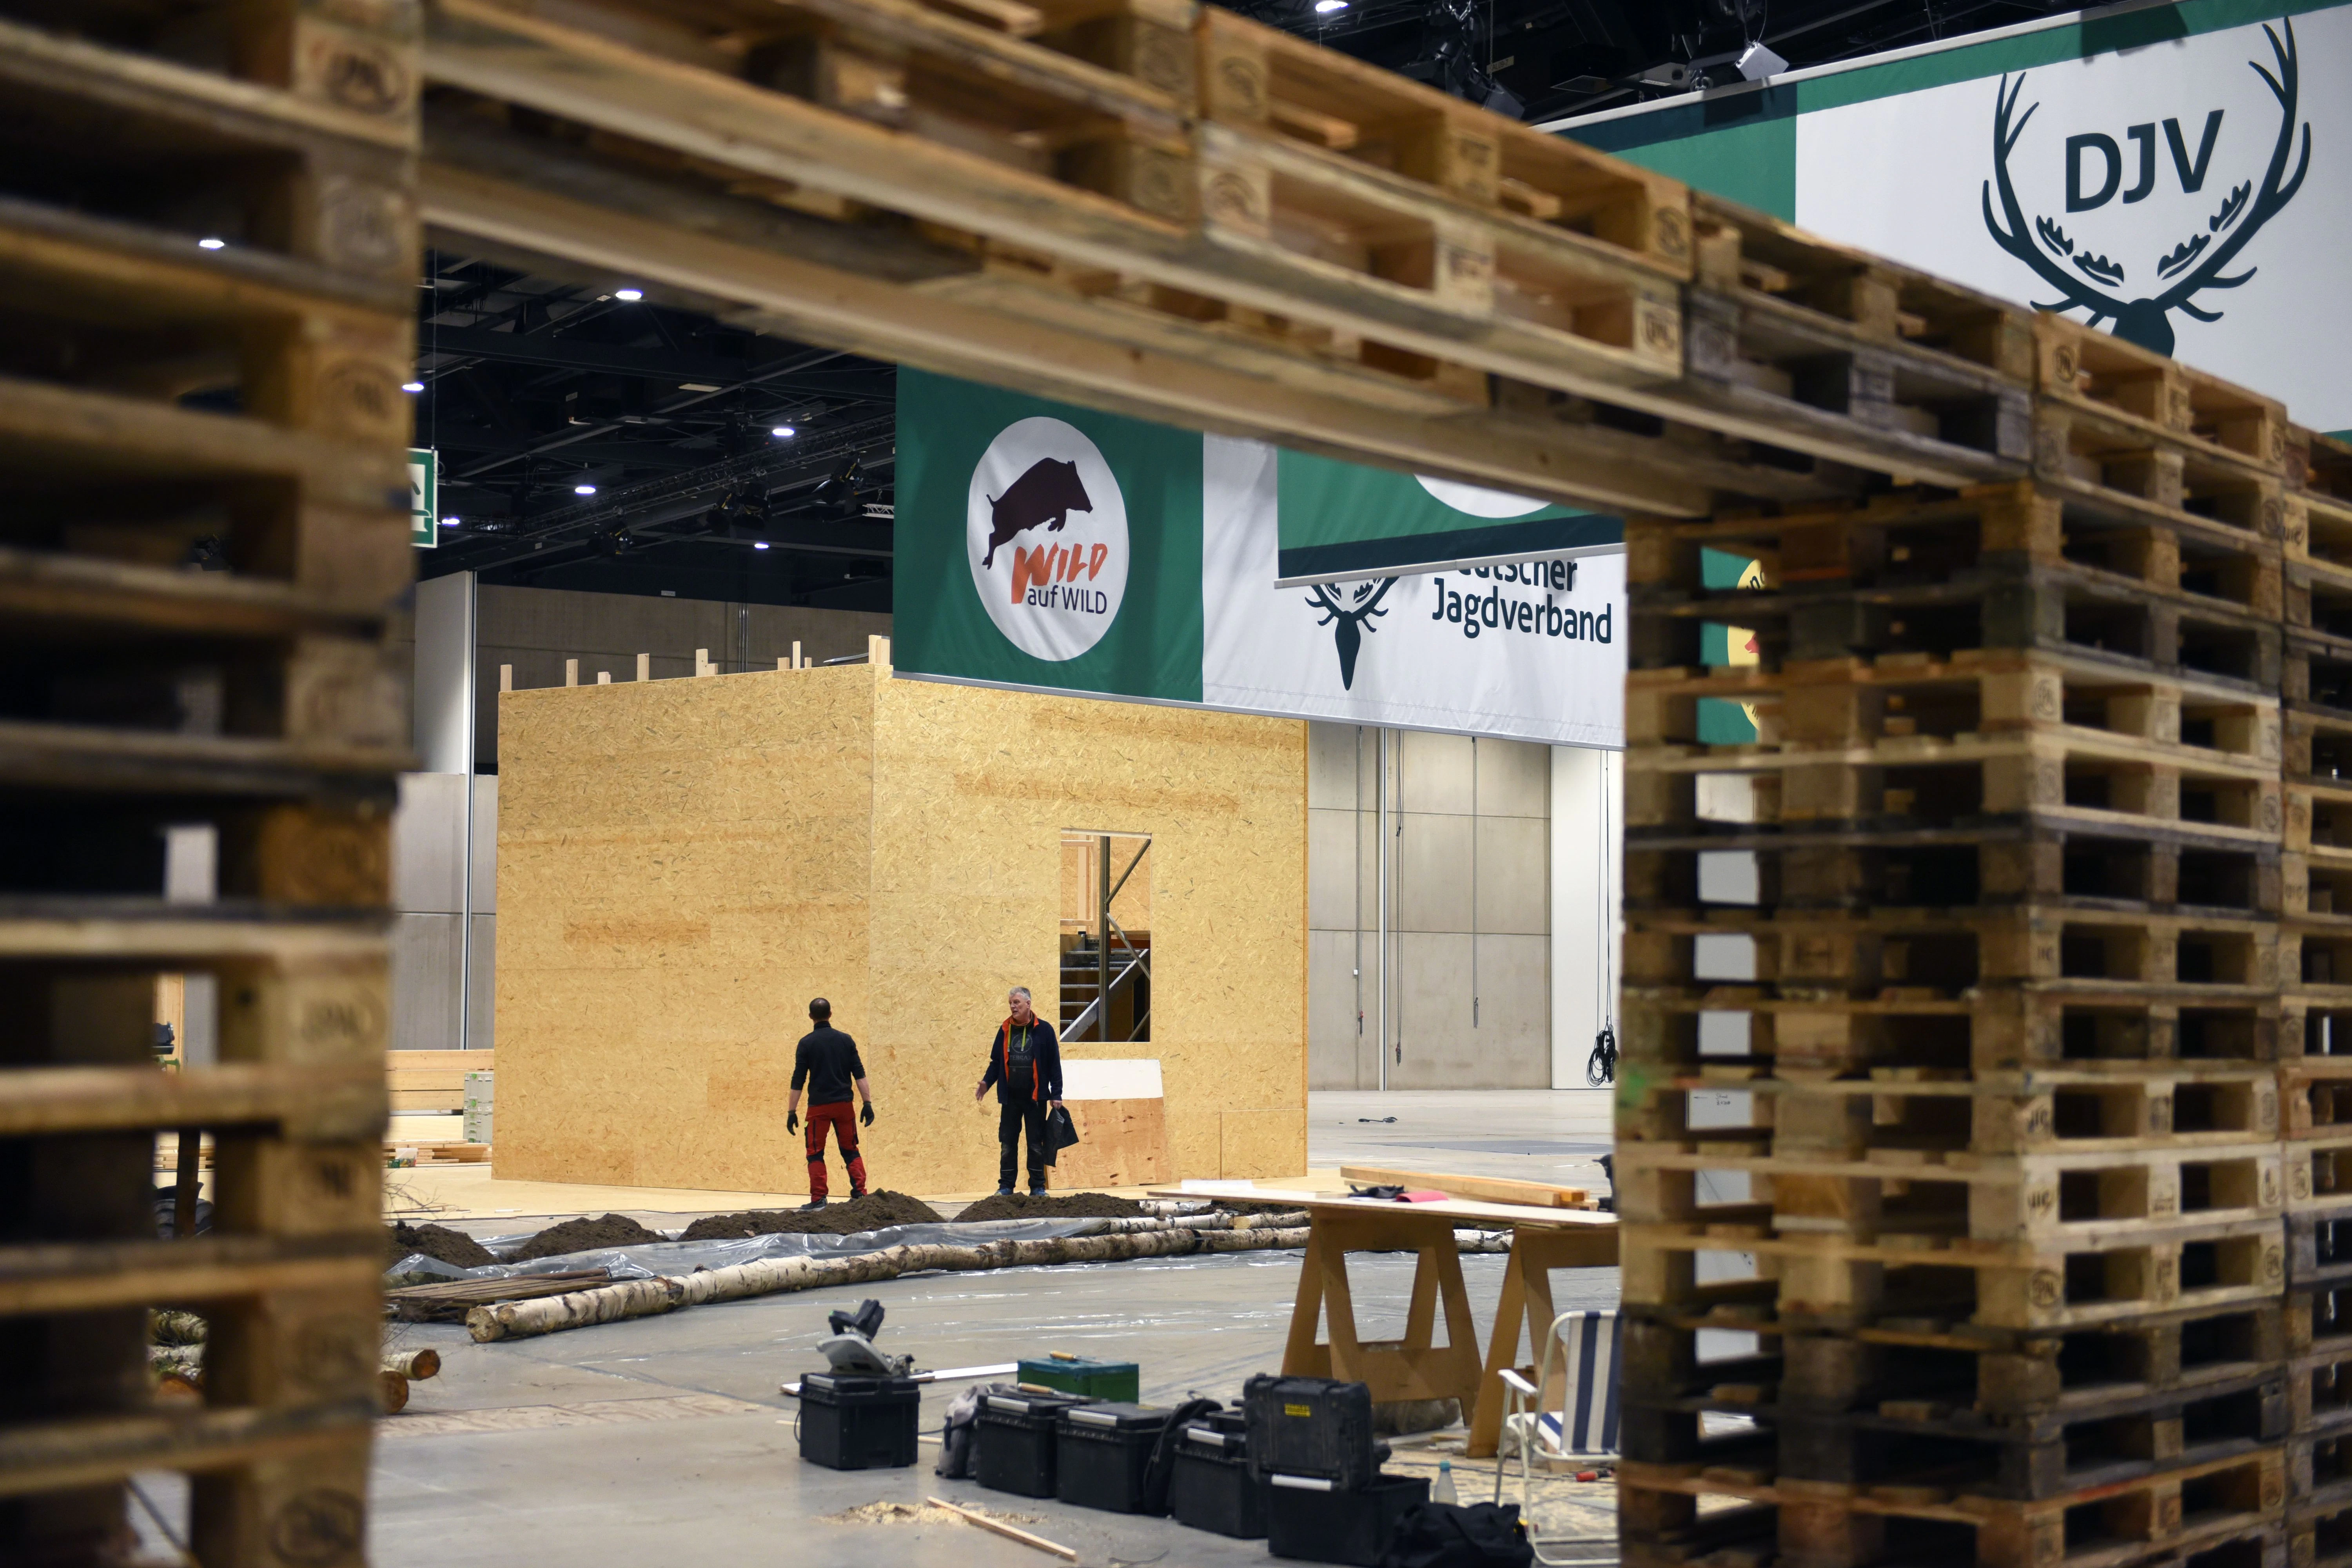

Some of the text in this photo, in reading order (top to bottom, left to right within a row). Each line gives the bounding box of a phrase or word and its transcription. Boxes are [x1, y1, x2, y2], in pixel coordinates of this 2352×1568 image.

[2066, 109, 2224, 213] DJV
[1011, 541, 1108, 604] WILD
[1027, 584, 1107, 614] auf WILD
[1432, 577, 1612, 644] Jagdverband
